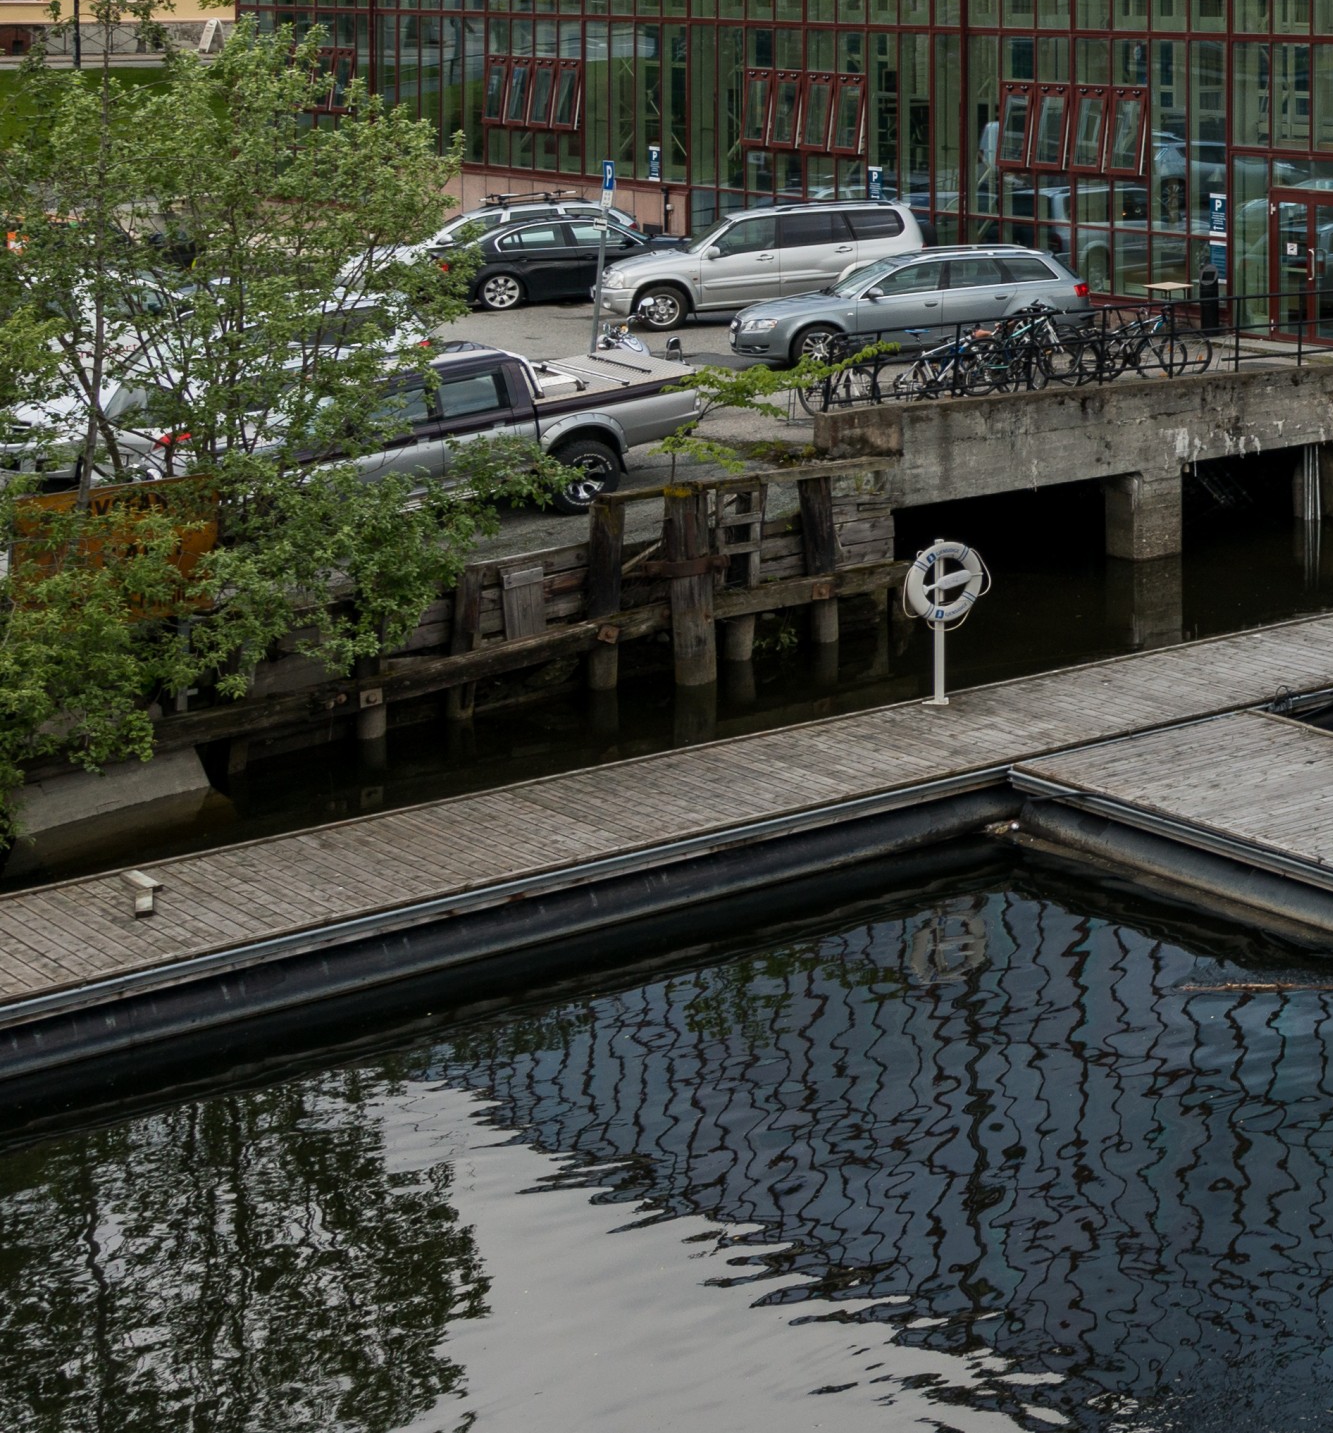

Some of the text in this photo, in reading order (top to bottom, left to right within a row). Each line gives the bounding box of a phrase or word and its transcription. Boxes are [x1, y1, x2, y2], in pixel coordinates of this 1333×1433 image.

[606, 164, 613, 187] P
[872, 171, 878, 182] P
[1215, 199, 1222, 211] P
